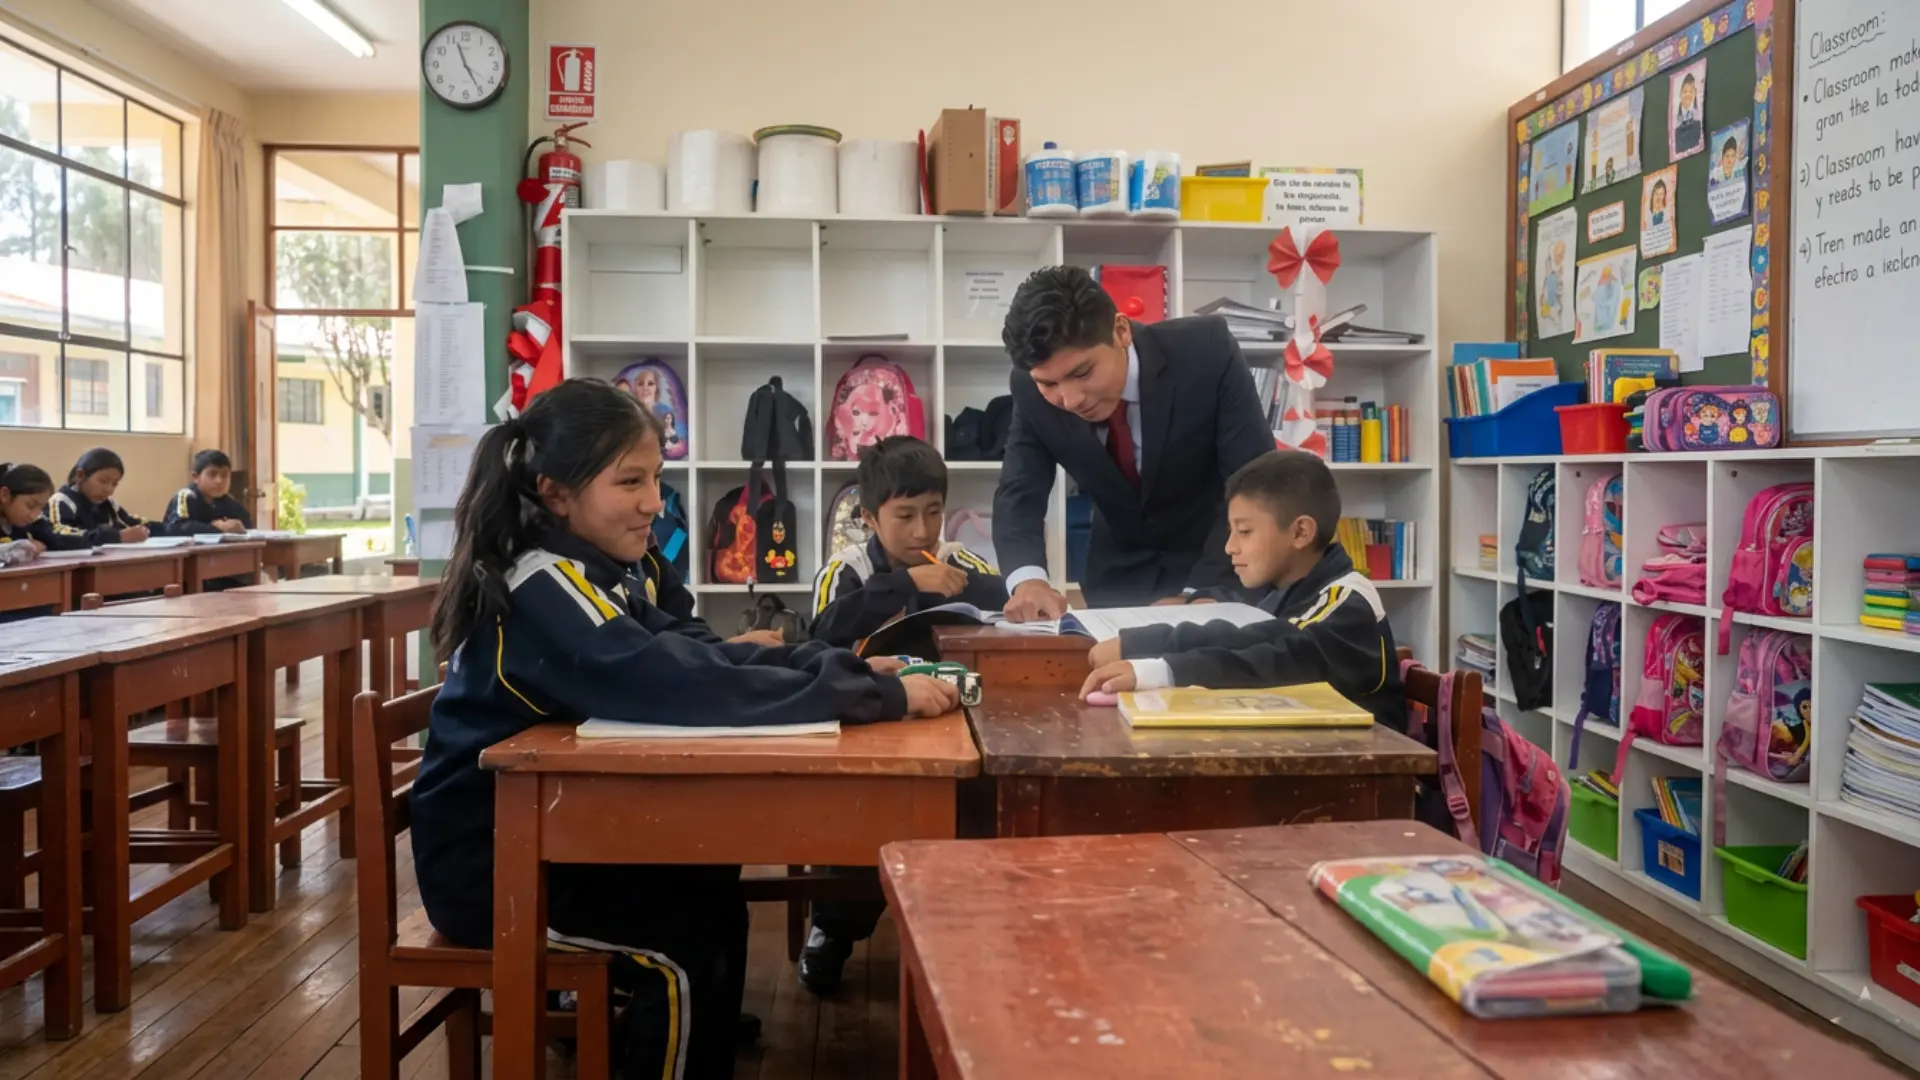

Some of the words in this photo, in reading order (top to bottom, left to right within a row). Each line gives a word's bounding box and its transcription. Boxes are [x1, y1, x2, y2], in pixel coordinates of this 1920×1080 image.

[446, 34, 456, 45] 11
[461, 31, 471, 42] 12
[436, 46, 446, 56] 10
[488, 46, 495, 57] 2
[492, 61, 499, 71] 3
[487, 75, 494, 85] 4
[1814, 66, 1879, 104] Classroom
[448, 85, 455, 96] 7
[1816, 111, 1843, 141] gran
[1849, 97, 1870, 117] the
[1876, 86, 1889, 108] la
[1816, 145, 1884, 180] Classroom
[1815, 196, 1823, 219] y
[1829, 178, 1862, 205] reads
[1868, 171, 1881, 192] to
[1887, 166, 1903, 187] be
[1815, 231, 1845, 255] Tren
[1853, 217, 1891, 246] made
[1866, 264, 1875, 278] a
